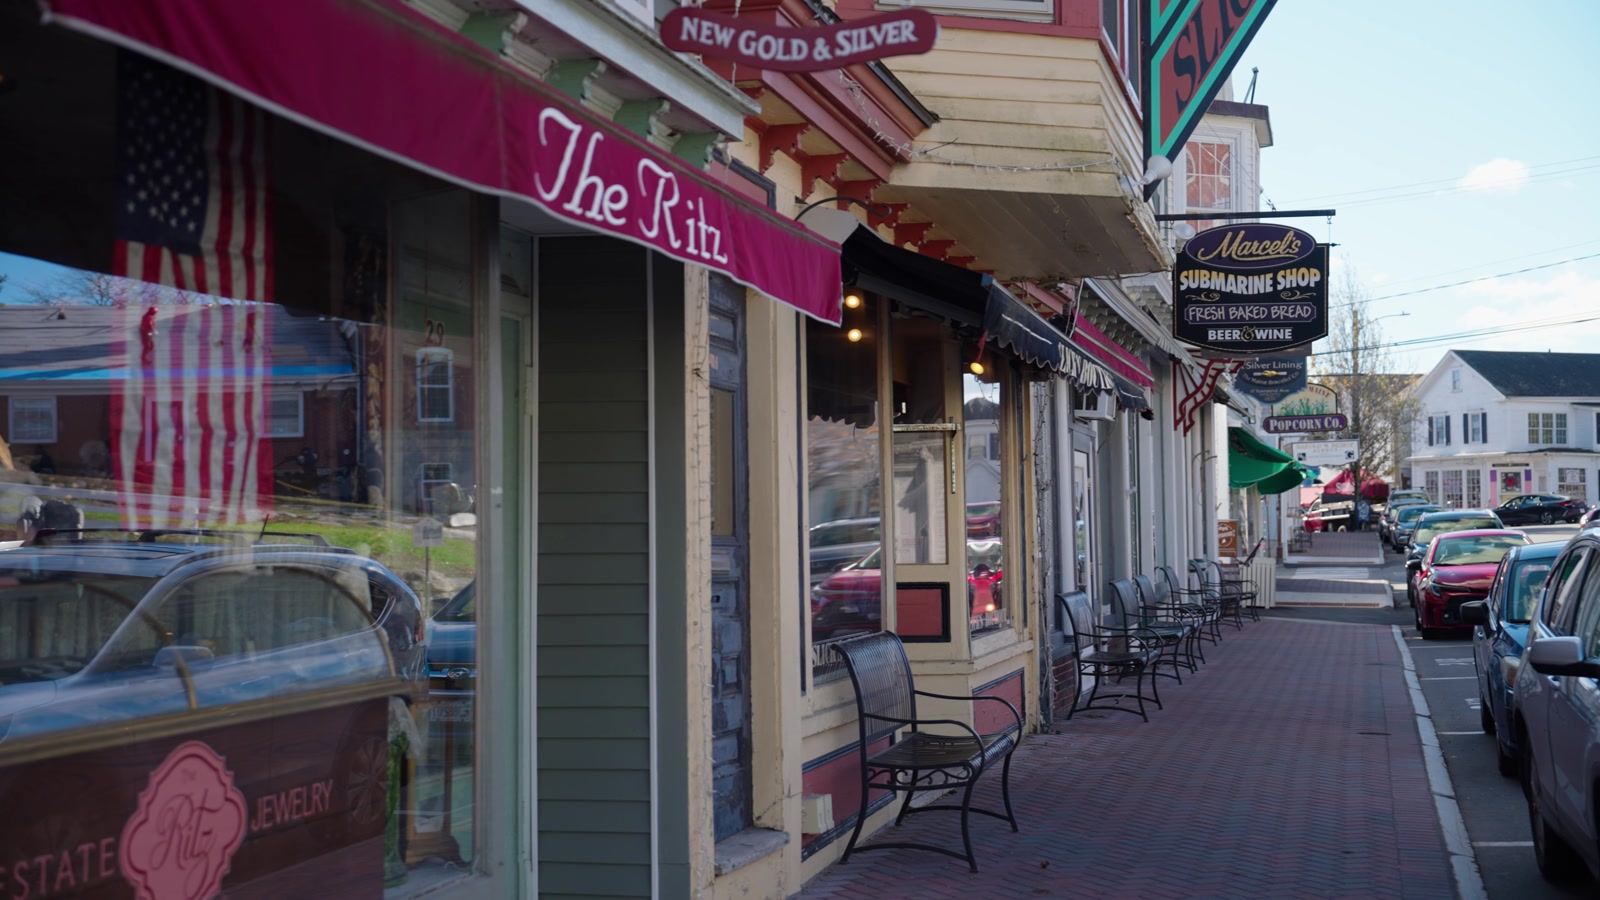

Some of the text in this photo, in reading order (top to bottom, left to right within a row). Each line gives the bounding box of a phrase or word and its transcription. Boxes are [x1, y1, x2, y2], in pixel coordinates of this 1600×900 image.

[680, 16, 917, 61] NEW GOLD & SILVER
[1173, 0, 1255, 115] SLI
[533, 106, 729, 265] The Ritz
[1197, 230, 1302, 262] Marcel's
[1179, 266, 1322, 296] SUBMARINE SHOP
[1188, 303, 1312, 322] FRESH BAKED BREAD
[1207, 326, 1293, 342] BEER & WINE
[1245, 360, 1303, 370] Silver Lining
[1269, 416, 1343, 432] POPCORN CO.
[251, 779, 334, 831] JEWELRY
[152, 788, 219, 900] Ritz
